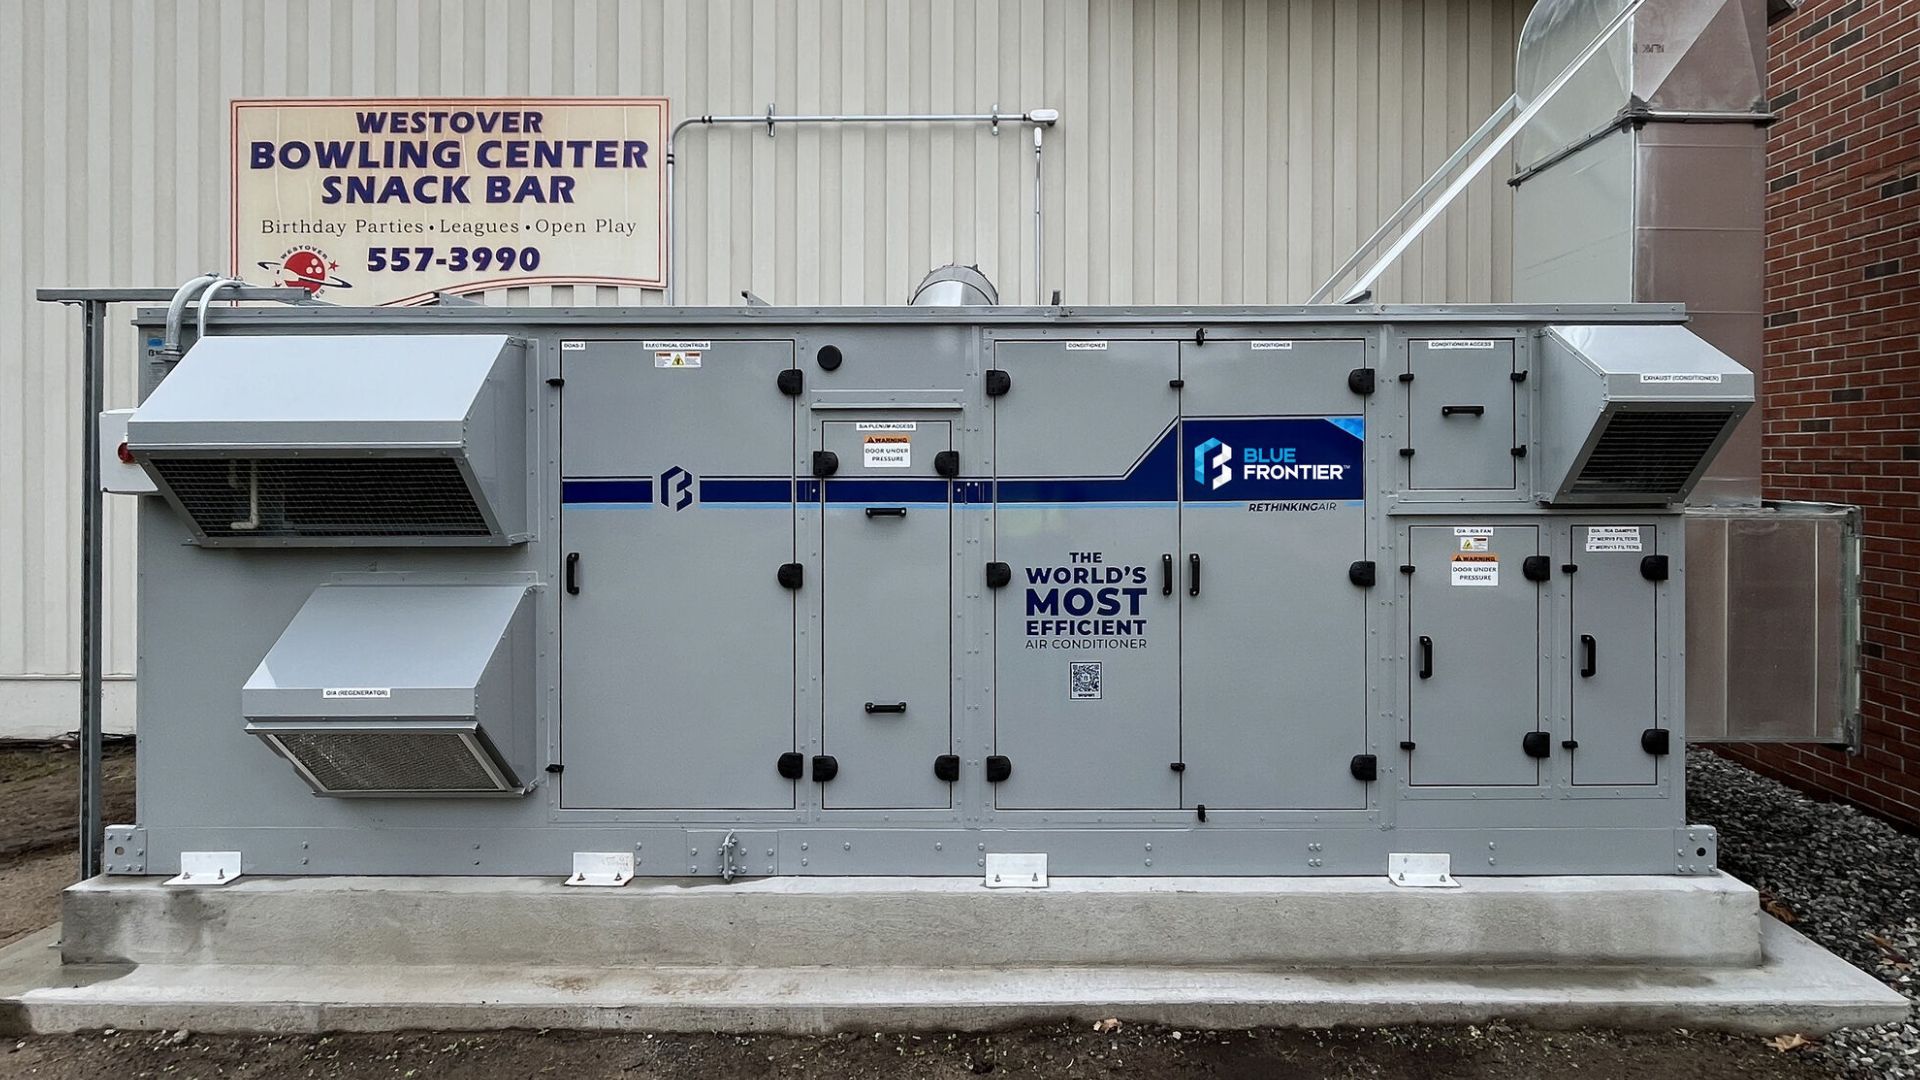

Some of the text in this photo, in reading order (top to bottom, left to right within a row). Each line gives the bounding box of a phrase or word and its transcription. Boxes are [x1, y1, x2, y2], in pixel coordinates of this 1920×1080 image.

[356, 112, 543, 133] WESTOVER
[250, 140, 649, 169] BOWLING CENTER
[321, 175, 575, 204] SNACK BAR
[262, 218, 637, 237] Birthday Parties Leagues Open Play
[280, 244, 329, 260] WESTOVER
[367, 246, 541, 272] 557-3990
[1243, 447, 1296, 463] BLUE
[1069, 552, 1102, 563] THE
[1025, 566, 1147, 584] WORLD'S
[1026, 587, 1147, 616] MOST
[1026, 620, 1147, 635] EFFICIENT
[1025, 639, 1147, 650] AIR CONDITIONER
[338, 689, 388, 697] (REGENERATOR)
